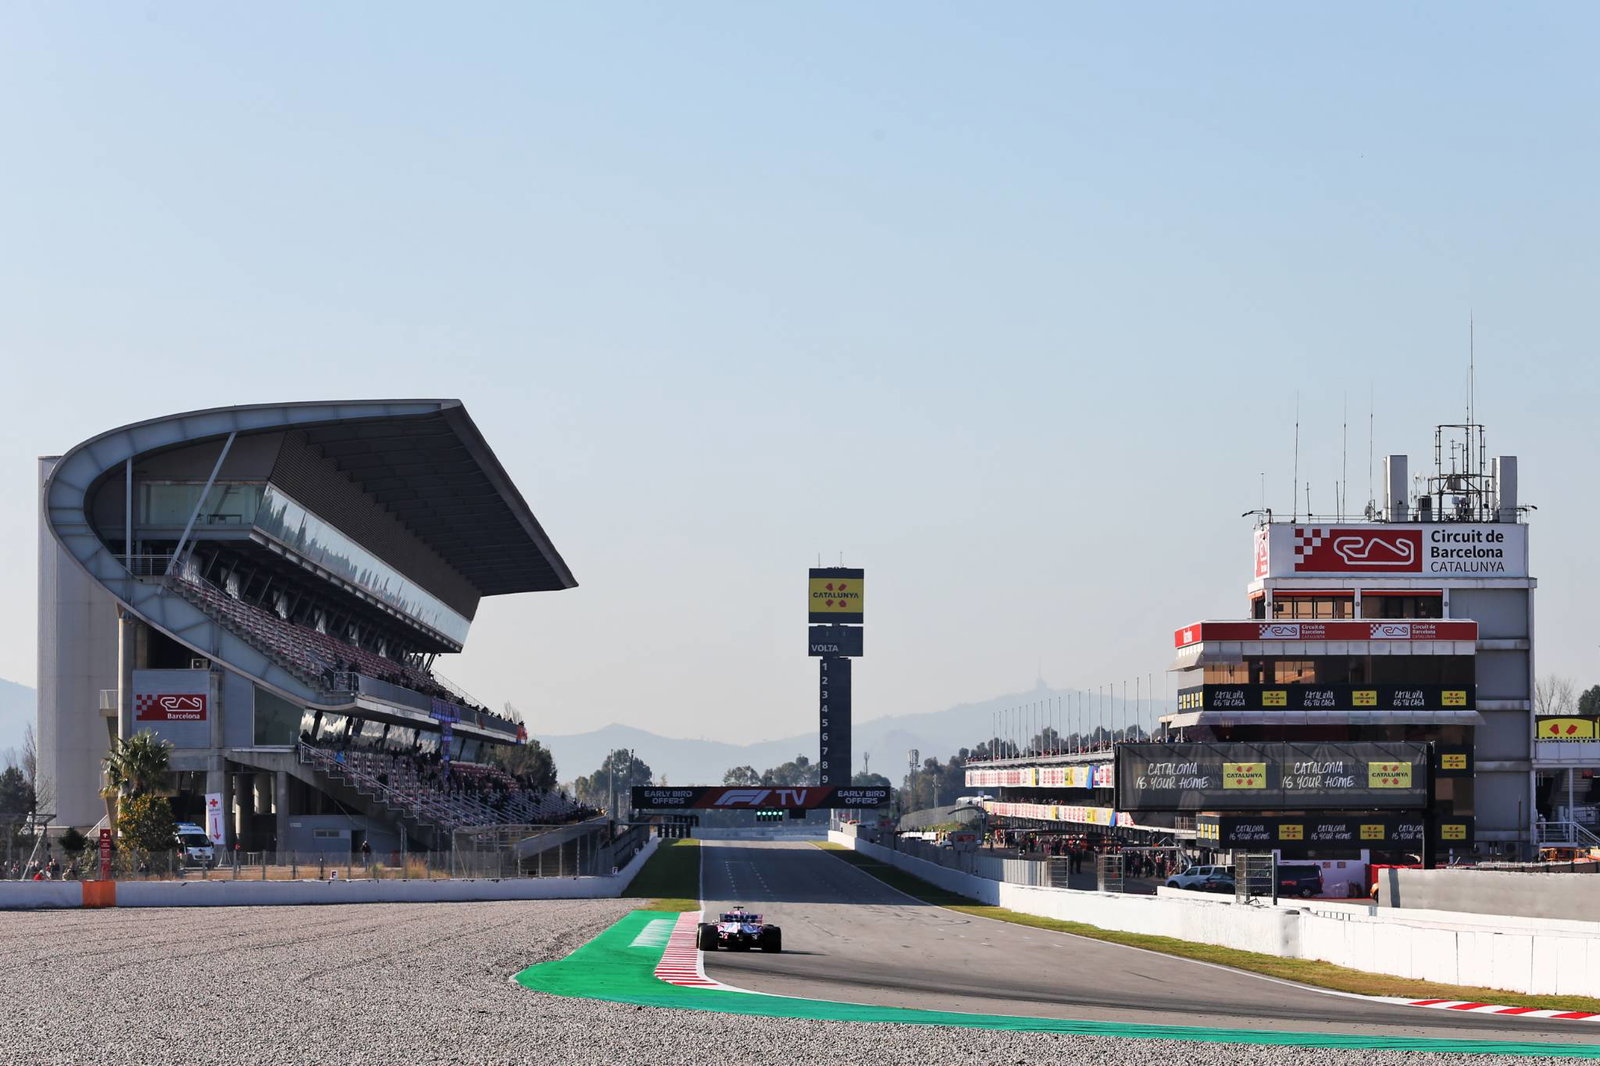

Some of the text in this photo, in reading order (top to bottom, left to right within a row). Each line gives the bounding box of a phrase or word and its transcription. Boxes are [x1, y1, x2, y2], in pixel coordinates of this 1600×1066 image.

[1431, 530, 1504, 543] Circuit de
[1431, 546, 1503, 558] Barcelona
[1431, 562, 1504, 572] CATALUNYA
[822, 663, 828, 671] 1
[822, 691, 828, 699] 3
[822, 719, 828, 727] 5
[822, 733, 828, 741] 6
[822, 747, 828, 755] 7
[822, 761, 828, 769] 8
[1148, 763, 1198, 776] CATALONIA
[1294, 761, 1343, 775] CATALONIA
[822, 775, 828, 783] 9
[1135, 776, 1209, 790] IS YOUR HOME
[1282, 775, 1354, 789] IS YOUR HOME
[714, 789, 807, 805] F1 TV
